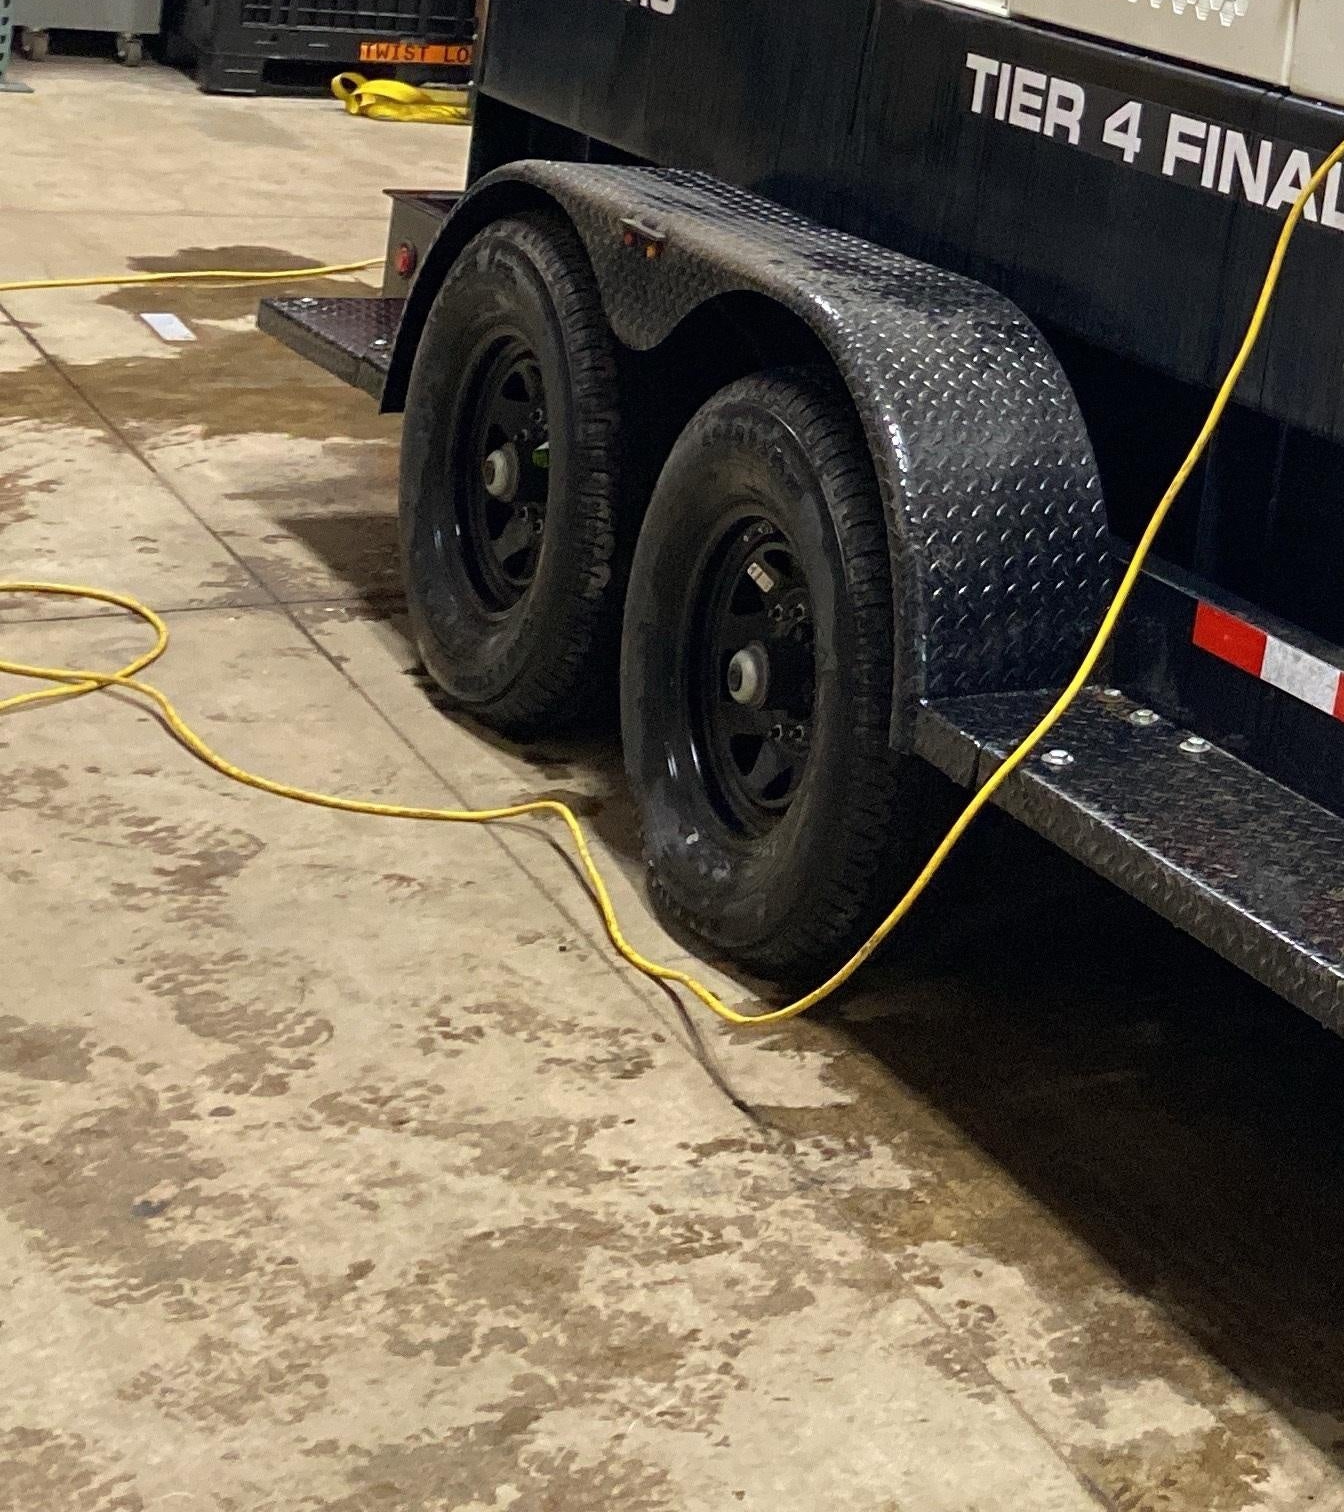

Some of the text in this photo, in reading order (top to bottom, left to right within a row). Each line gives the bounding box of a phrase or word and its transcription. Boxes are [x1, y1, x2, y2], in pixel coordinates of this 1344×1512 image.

[363, 43, 428, 63] TWIST
[966, 53, 1086, 146] TIER
[1102, 100, 1143, 164] 4
